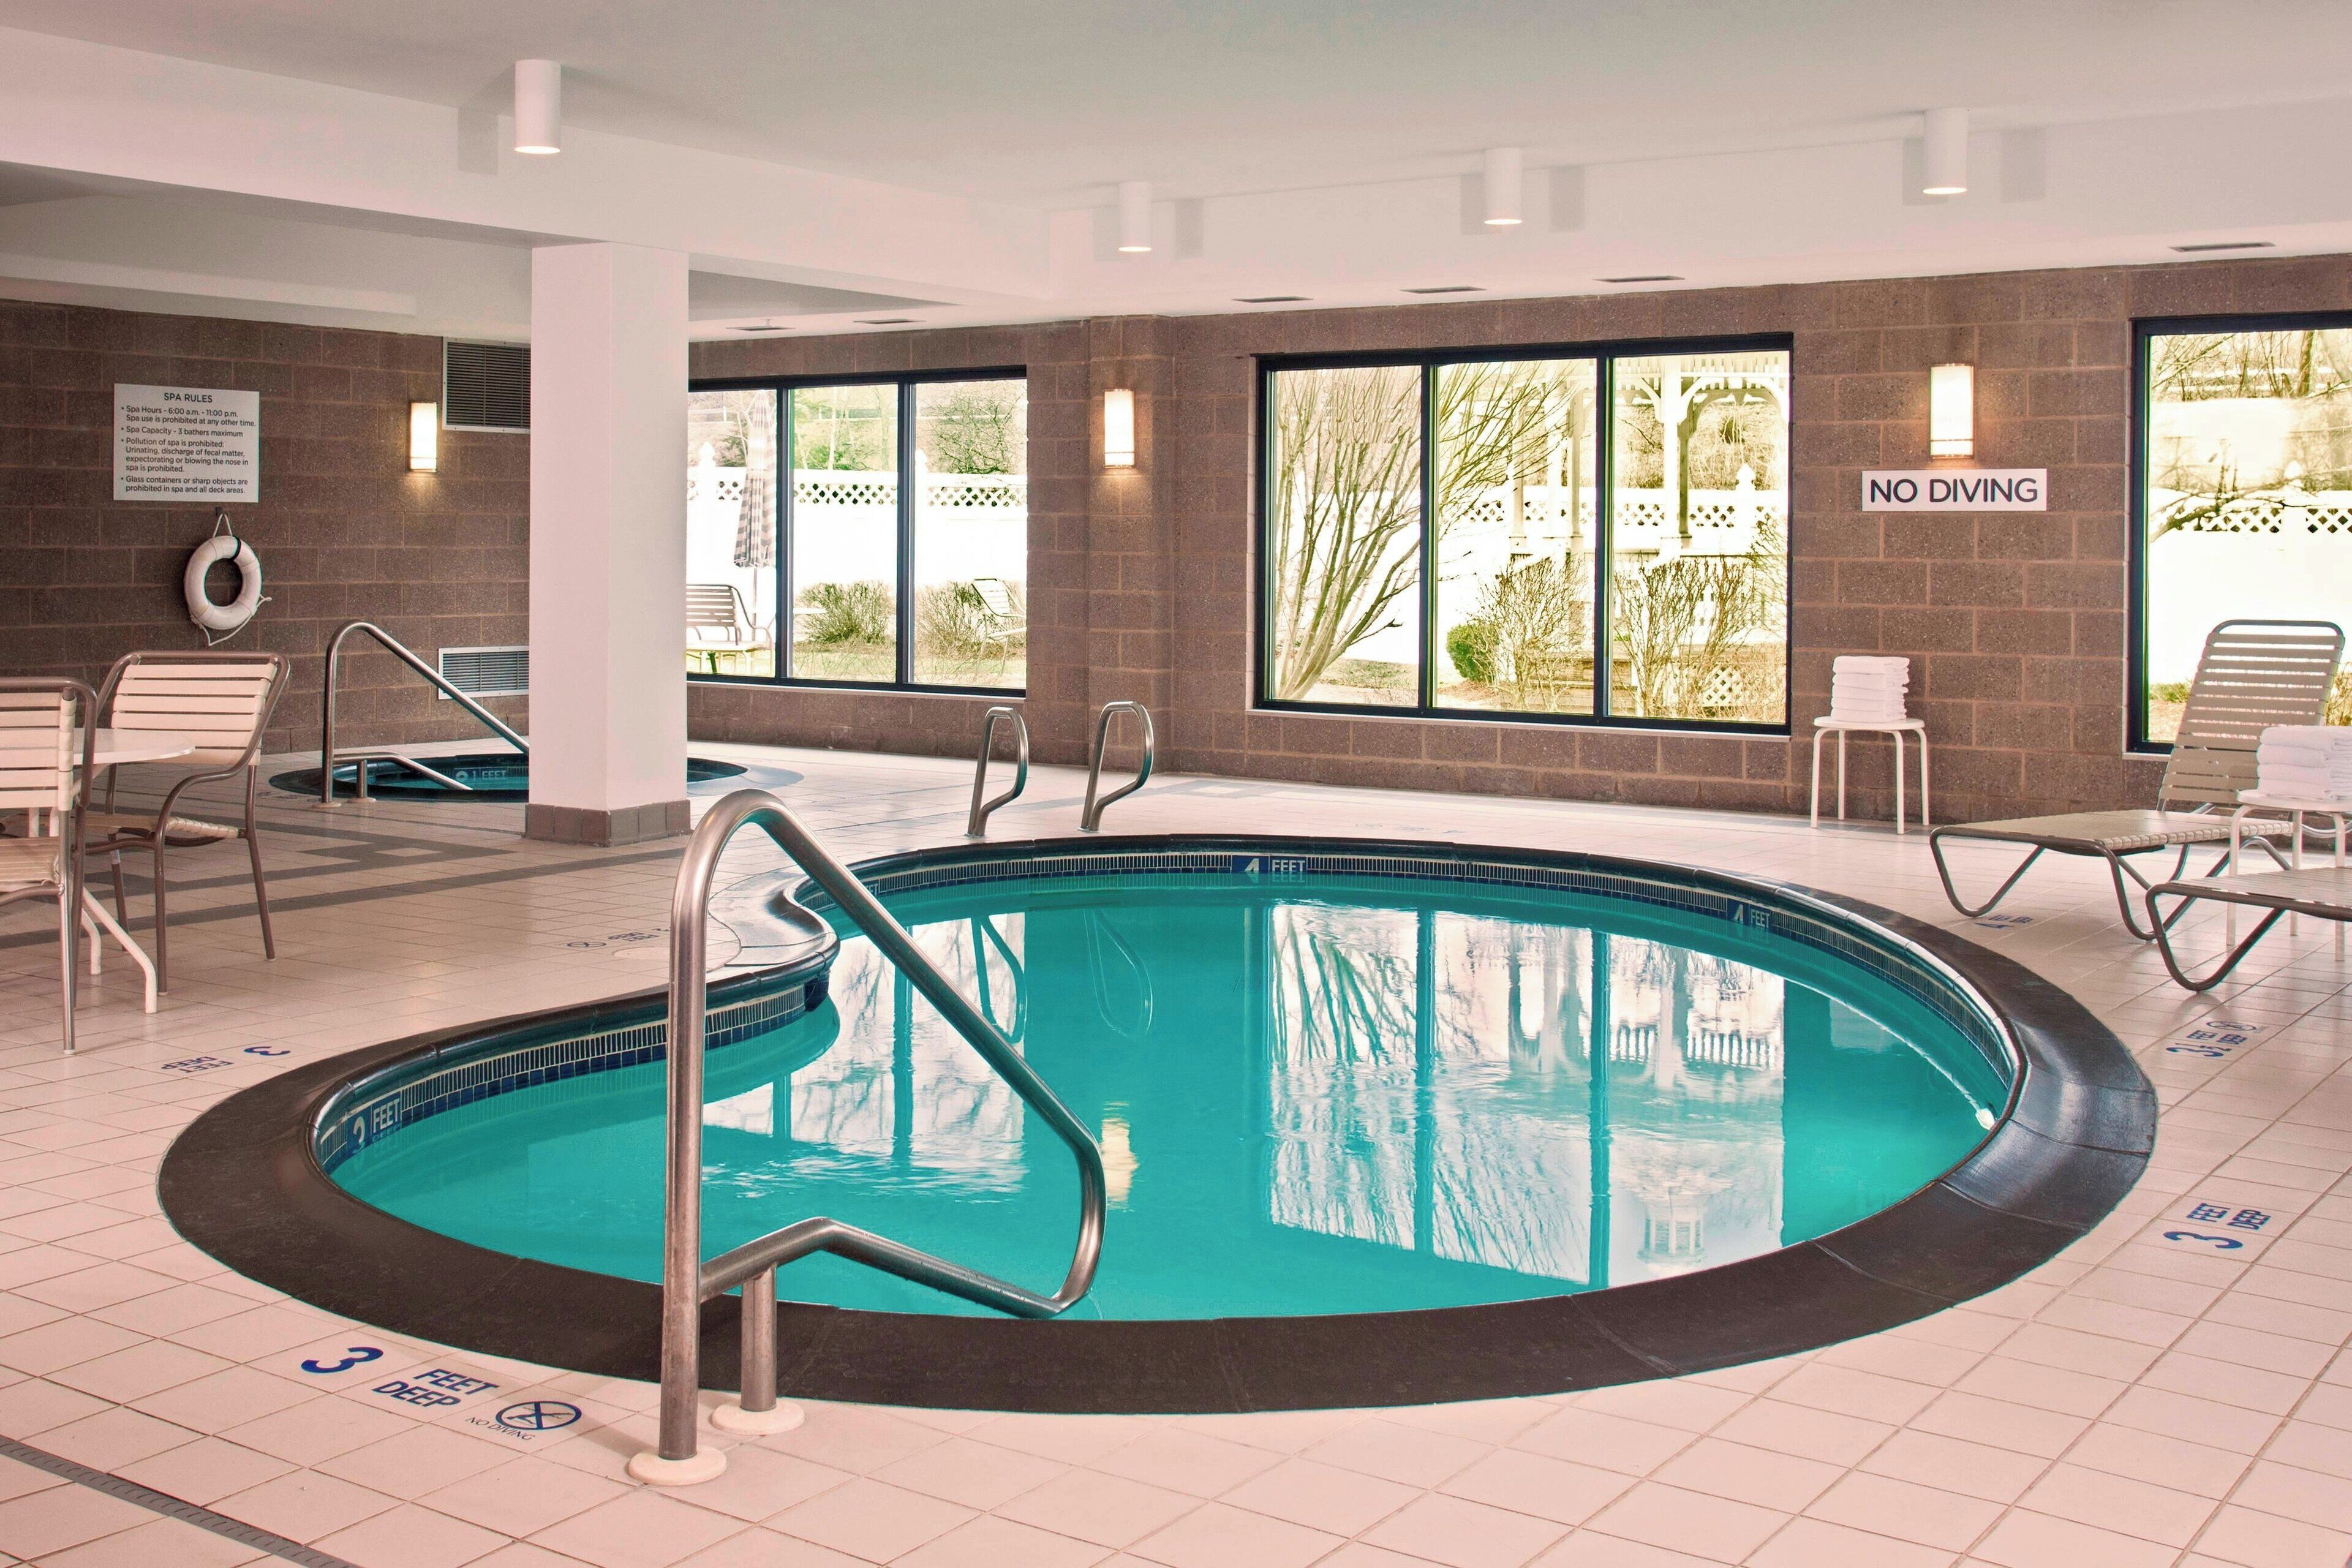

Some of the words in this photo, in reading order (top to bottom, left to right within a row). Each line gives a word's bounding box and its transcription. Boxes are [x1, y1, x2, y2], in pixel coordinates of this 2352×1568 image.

[164, 393, 182, 401] SPA
[184, 394, 213, 403] RULES
[141, 426, 172, 435] Capacity
[161, 447, 194, 456] discharge
[184, 457, 211, 466] blowing
[1870, 478, 1918, 503] NO
[1929, 478, 2038, 503] DIVING
[1272, 859, 1305, 872] FEET
[1751, 909, 1770, 929] FEET
[244, 1046, 291, 1056] 3
[161, 1056, 218, 1069] DEEP
[178, 1060, 234, 1073] FEET
[373, 1098, 400, 1133] FEET
[2186, 1202, 2231, 1223] FEET
[2226, 1209, 2271, 1230] DEEP
[2163, 1231, 2243, 1249] 3
[301, 1346, 384, 1374] 3
[412, 1368, 502, 1396] FEET
[371, 1380, 461, 1408] DEEP
[466, 1417, 490, 1426] NO
[487, 1423, 536, 1441] DIVING
